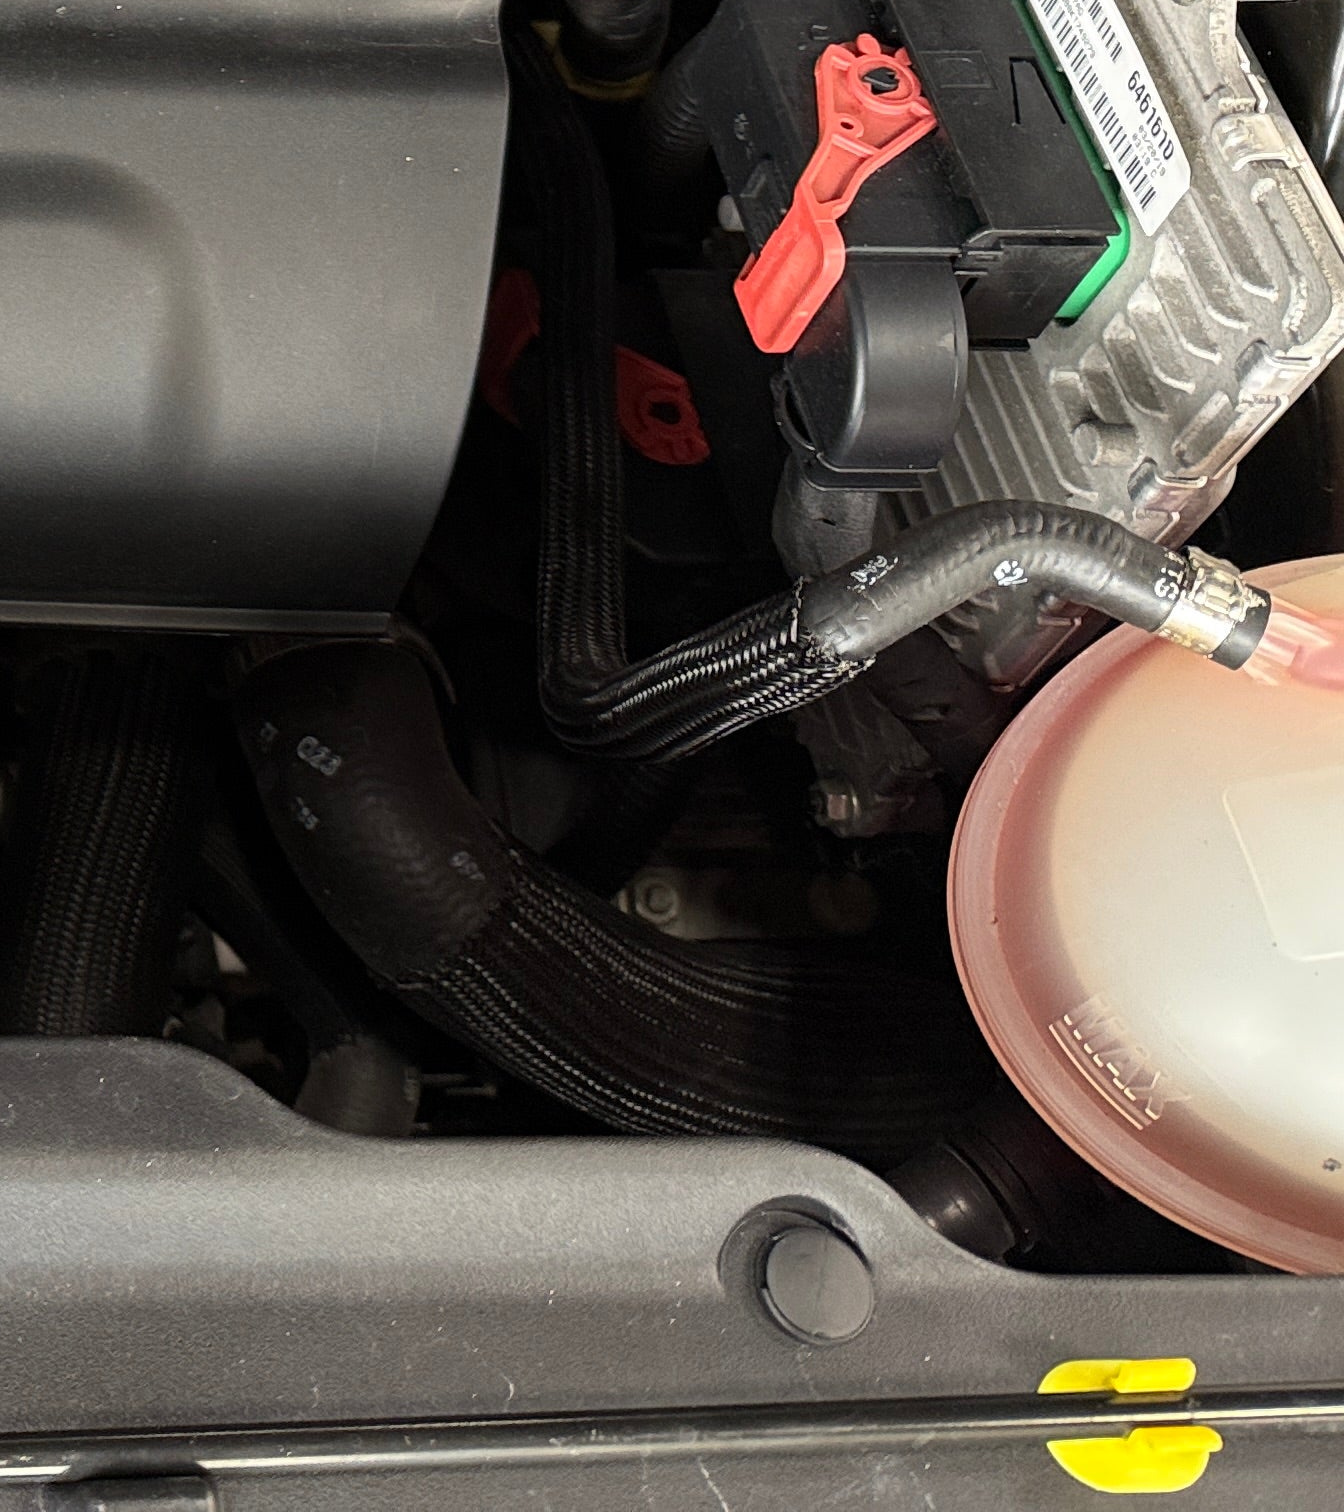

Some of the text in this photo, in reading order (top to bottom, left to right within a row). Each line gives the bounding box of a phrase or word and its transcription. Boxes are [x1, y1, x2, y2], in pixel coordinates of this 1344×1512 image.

[1128, 69, 1175, 161] 6461610
[1138, 123, 1166, 178] 03/20/19
[1063, 996, 1192, 1122] MAX
